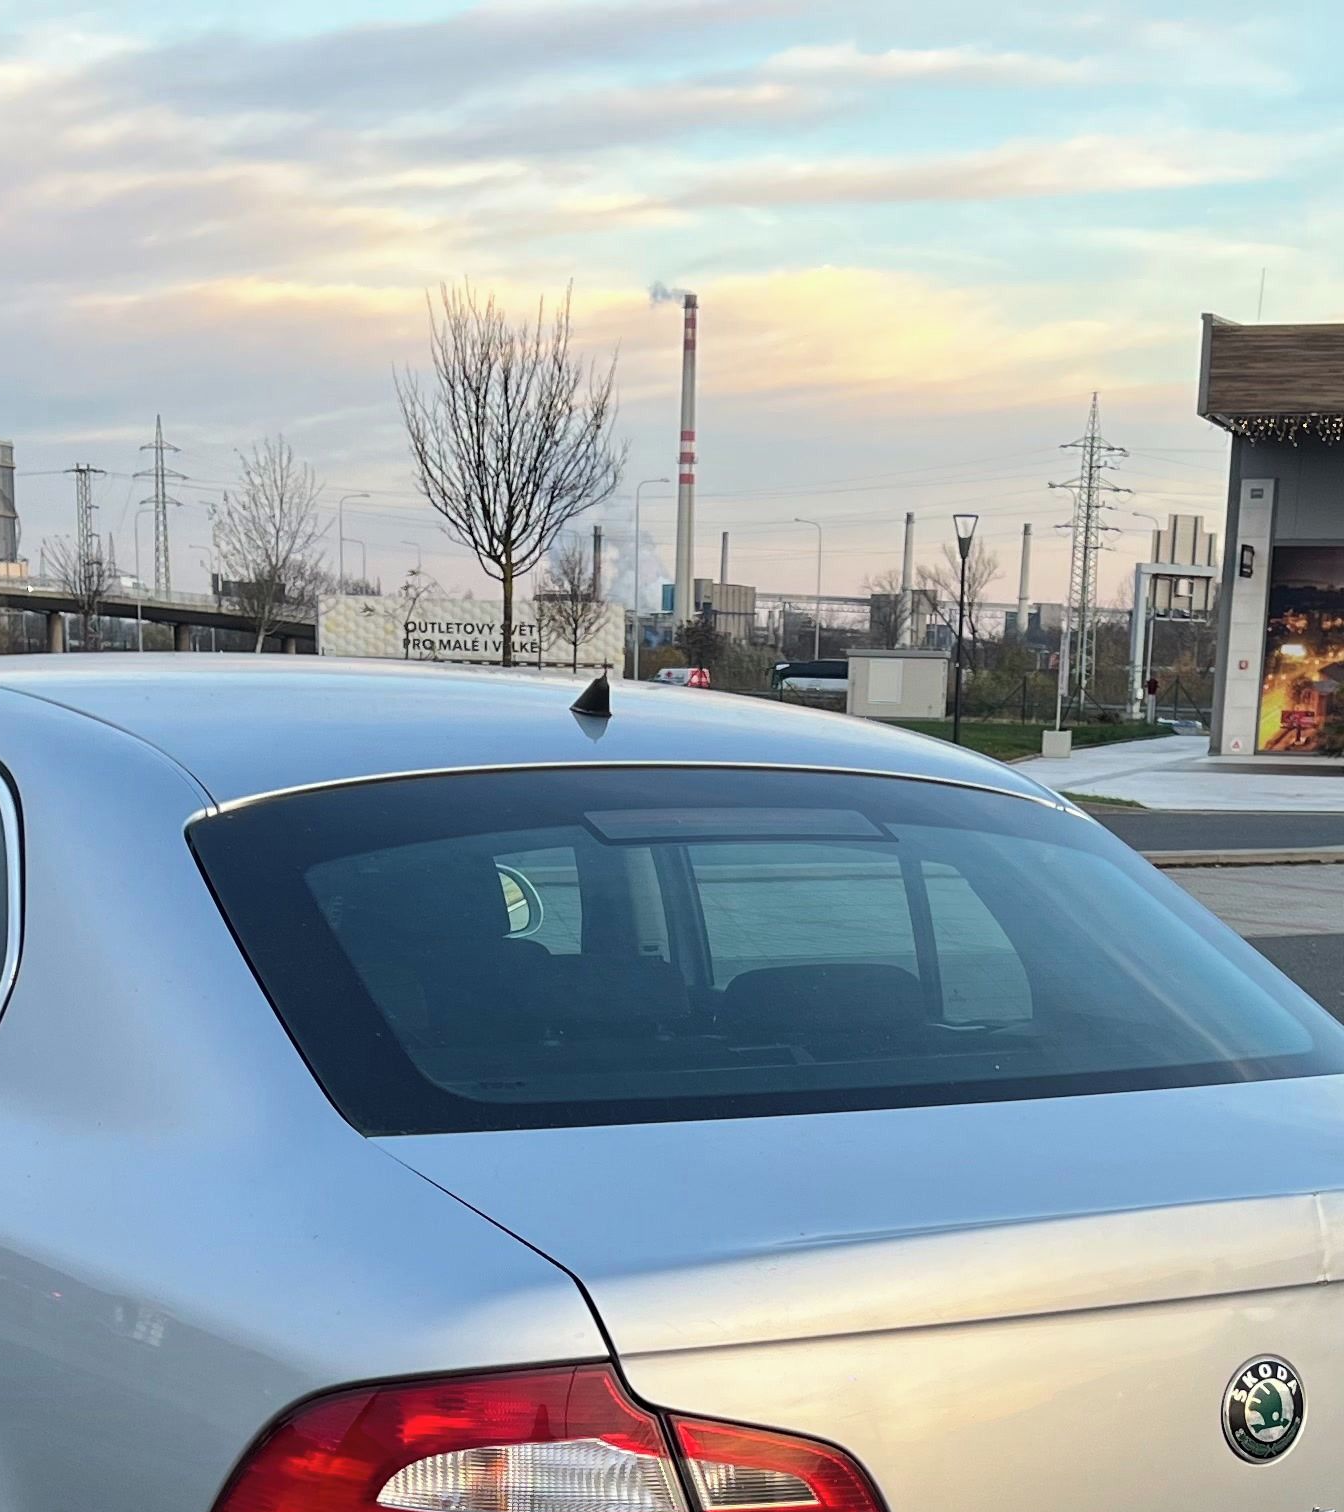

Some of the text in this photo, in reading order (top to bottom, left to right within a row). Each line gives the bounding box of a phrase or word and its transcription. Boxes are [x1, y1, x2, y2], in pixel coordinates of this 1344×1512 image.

[404, 620, 495, 635] OUTLETOVÝ
[403, 638, 434, 651] PRO
[439, 637, 480, 651] MALÉ
[493, 639, 539, 653] VLKÉ
